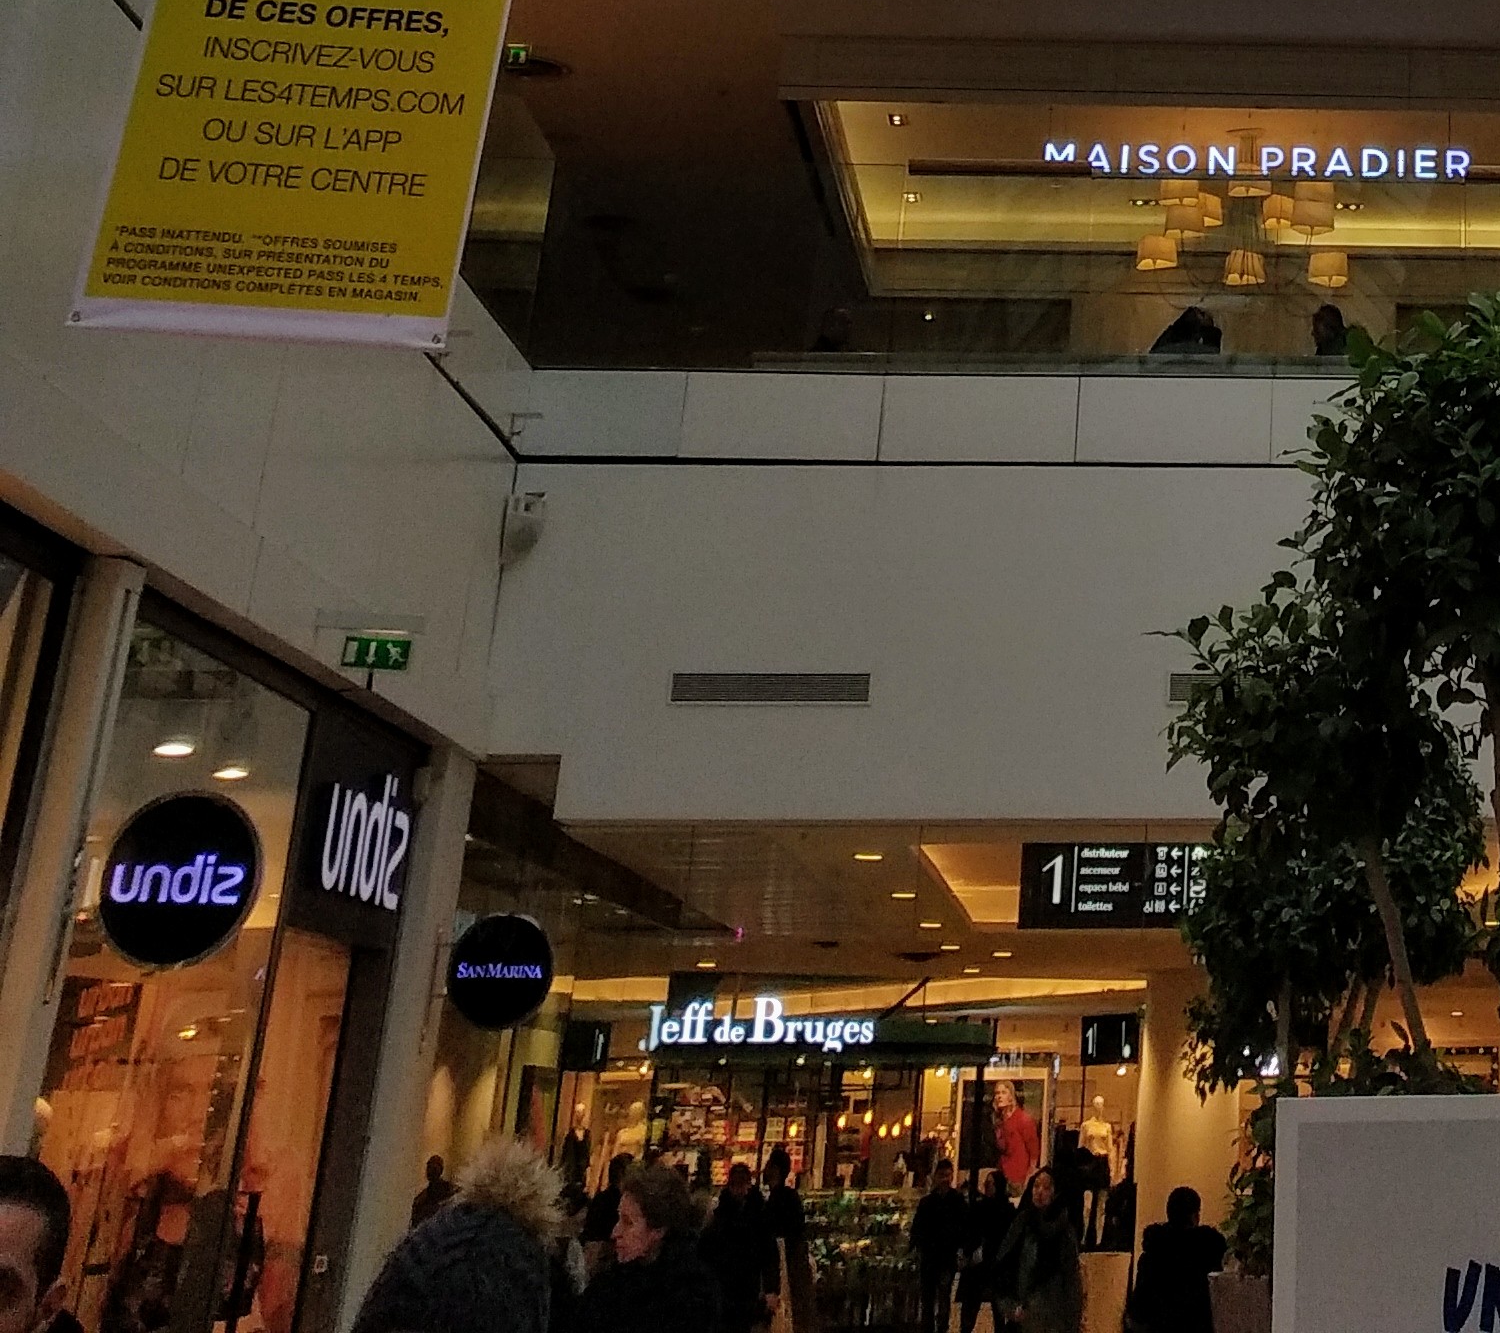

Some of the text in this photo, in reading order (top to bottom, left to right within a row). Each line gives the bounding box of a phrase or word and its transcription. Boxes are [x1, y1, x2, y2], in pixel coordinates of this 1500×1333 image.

[255, 0, 316, 25] CES
[326, 5, 451, 37] OFFRES,
[203, 36, 435, 74] INSCRIVEZ-VOUS
[155, 74, 465, 116] SUR LES4TEMPS.COM
[202, 118, 402, 154] OU SUR L'APP
[158, 157, 428, 198] DE VOTRE CENTRE
[1043, 142, 1473, 179] MAISON PRADIER
[106, 257, 202, 272] PROGRAMME
[207, 263, 303, 279] UNEXPECTED
[307, 269, 345, 282] PASS
[349, 272, 378, 284] LES
[222, 248, 252, 260] SUR
[368, 257, 390, 269] DU
[102, 273, 137, 284] VOIR
[141, 275, 231, 291] CONDITIONS
[328, 286, 347, 297] EN
[110, 854, 244, 905] undiz
[1042, 854, 1063, 905] 1
[1079, 884, 1107, 893] espace
[639, 1002, 714, 1052] Jeff
[714, 1014, 745, 1044] de
[746, 997, 874, 1053] Bruges
